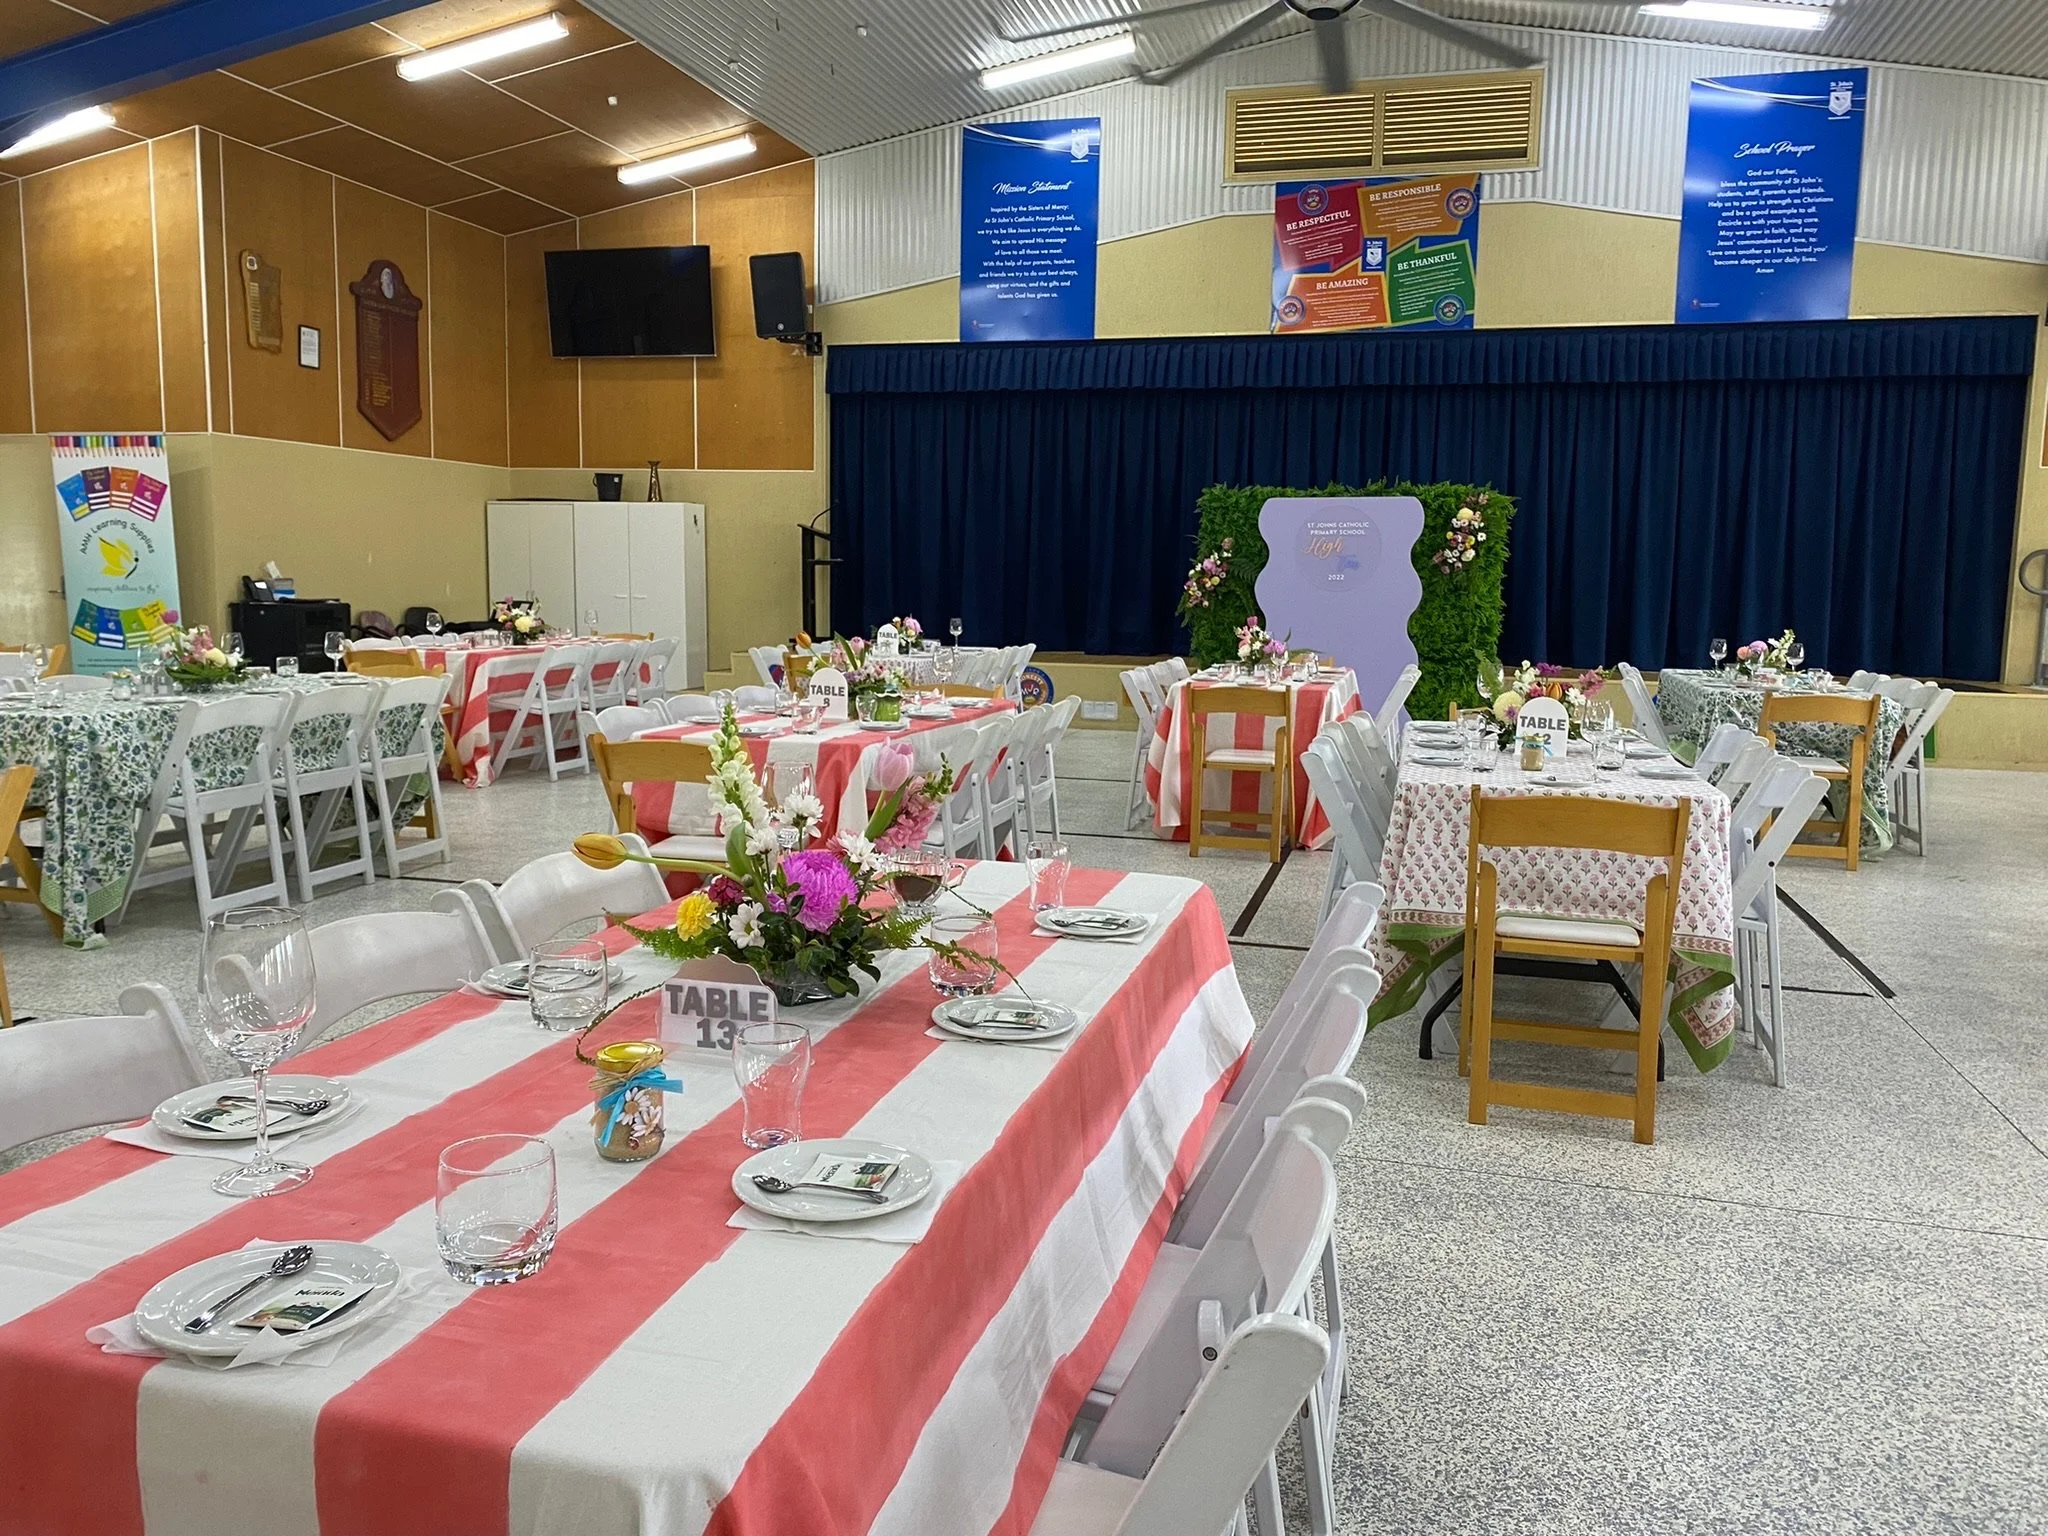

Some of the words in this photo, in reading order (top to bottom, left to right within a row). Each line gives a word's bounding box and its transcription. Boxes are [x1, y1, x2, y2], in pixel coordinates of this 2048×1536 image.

[1734, 143, 1775, 158] School
[1774, 141, 1816, 157] Prayer
[992, 182, 1026, 195] Mission
[1027, 180, 1074, 194] Statement
[1369, 193, 1381, 202] BE
[1382, 184, 1442, 200] RESPONSIBLE
[1286, 222, 1298, 231] BE
[1299, 210, 1351, 228] RESPECTFUL
[1397, 262, 1409, 271] BE
[1409, 252, 1457, 268] THANKFUL
[1316, 282, 1328, 290] BE
[1328, 278, 1368, 288] AMAZING
[80, 533, 92, 555] AMH
[91, 518, 128, 533] Learning
[130, 522, 155, 554] Supplies
[1304, 536, 1344, 561] High
[1020, 674, 1044, 685] ONESTY
[811, 685, 845, 697] TABLE
[1520, 716, 1566, 731] TABLE
[665, 984, 769, 1022] TABLE
[696, 1018, 736, 1050] 13
